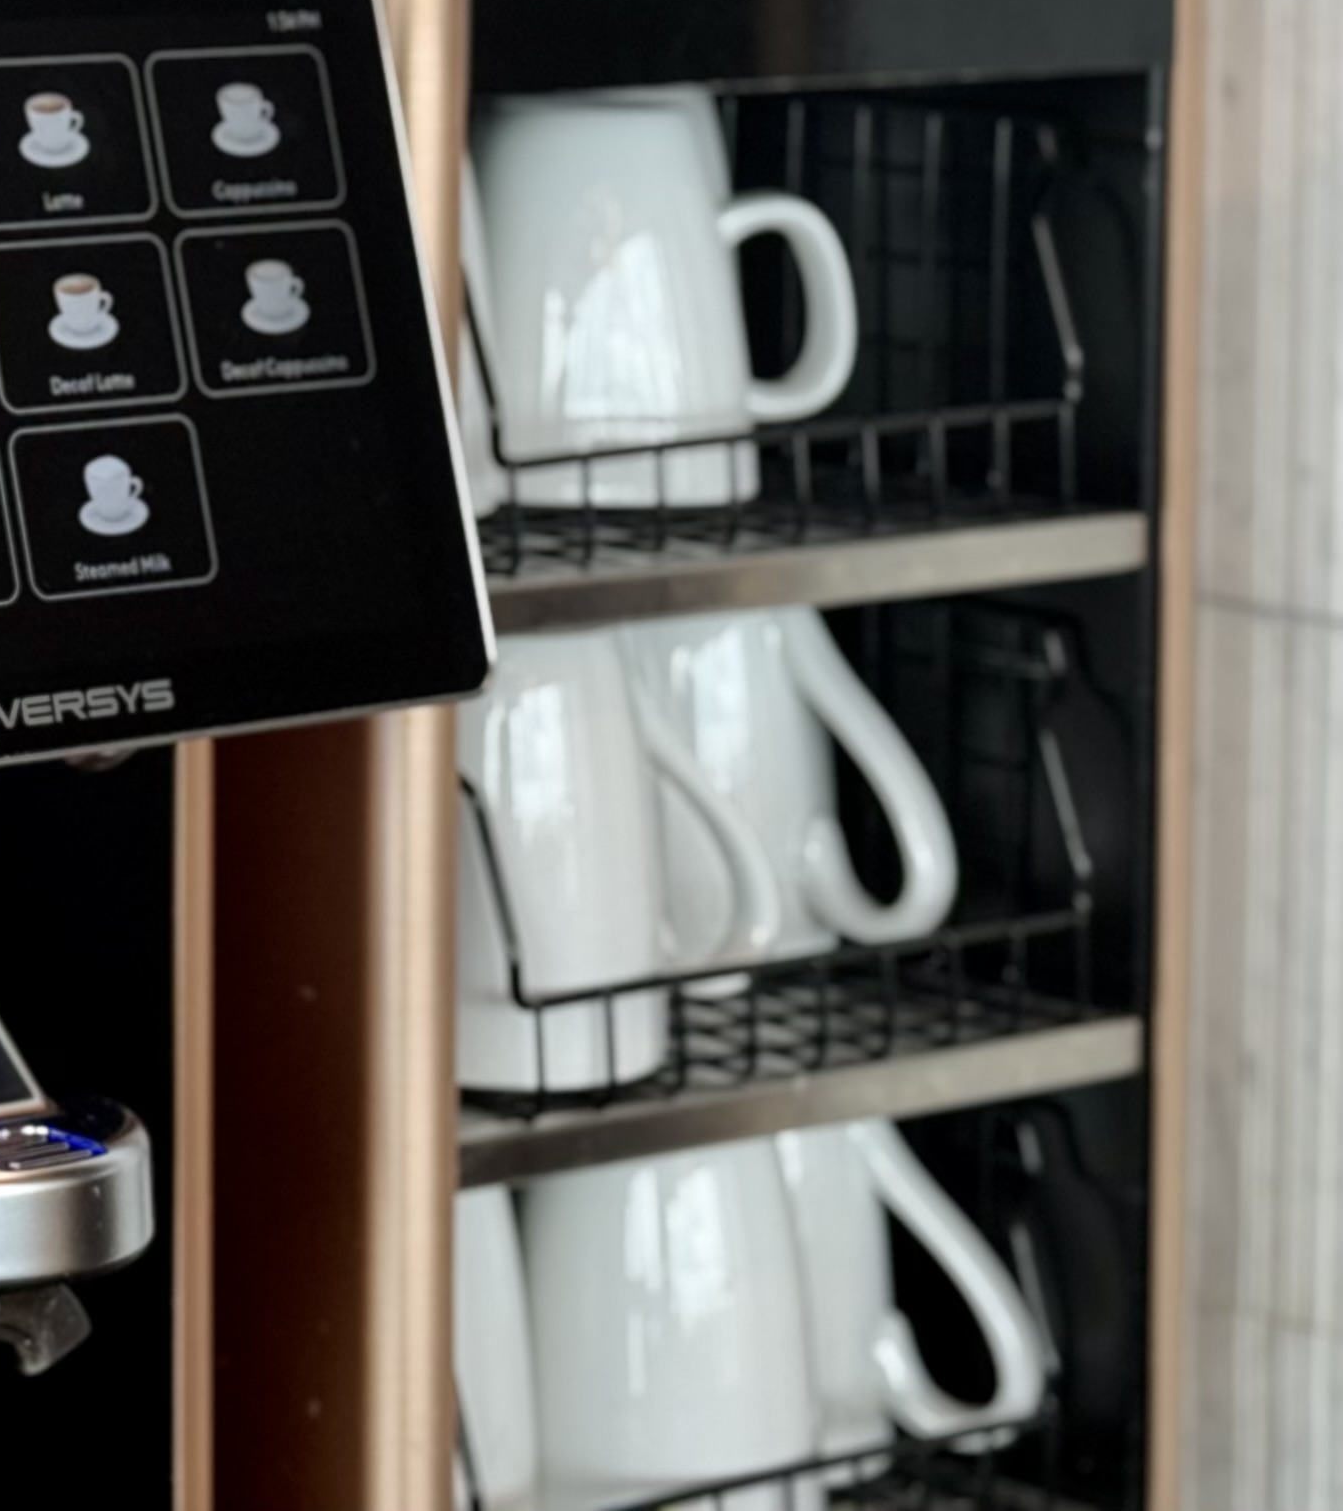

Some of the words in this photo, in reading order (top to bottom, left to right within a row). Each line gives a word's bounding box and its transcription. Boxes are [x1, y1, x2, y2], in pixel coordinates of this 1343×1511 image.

[212, 178, 298, 202] Cappuccino
[43, 194, 83, 211] Latte
[221, 360, 264, 381] Decaf
[264, 355, 349, 378] Cappuccino
[50, 374, 94, 396] Decaf
[95, 374, 135, 392] Latte
[75, 559, 138, 581] Steamed
[141, 555, 171, 574] Milk
